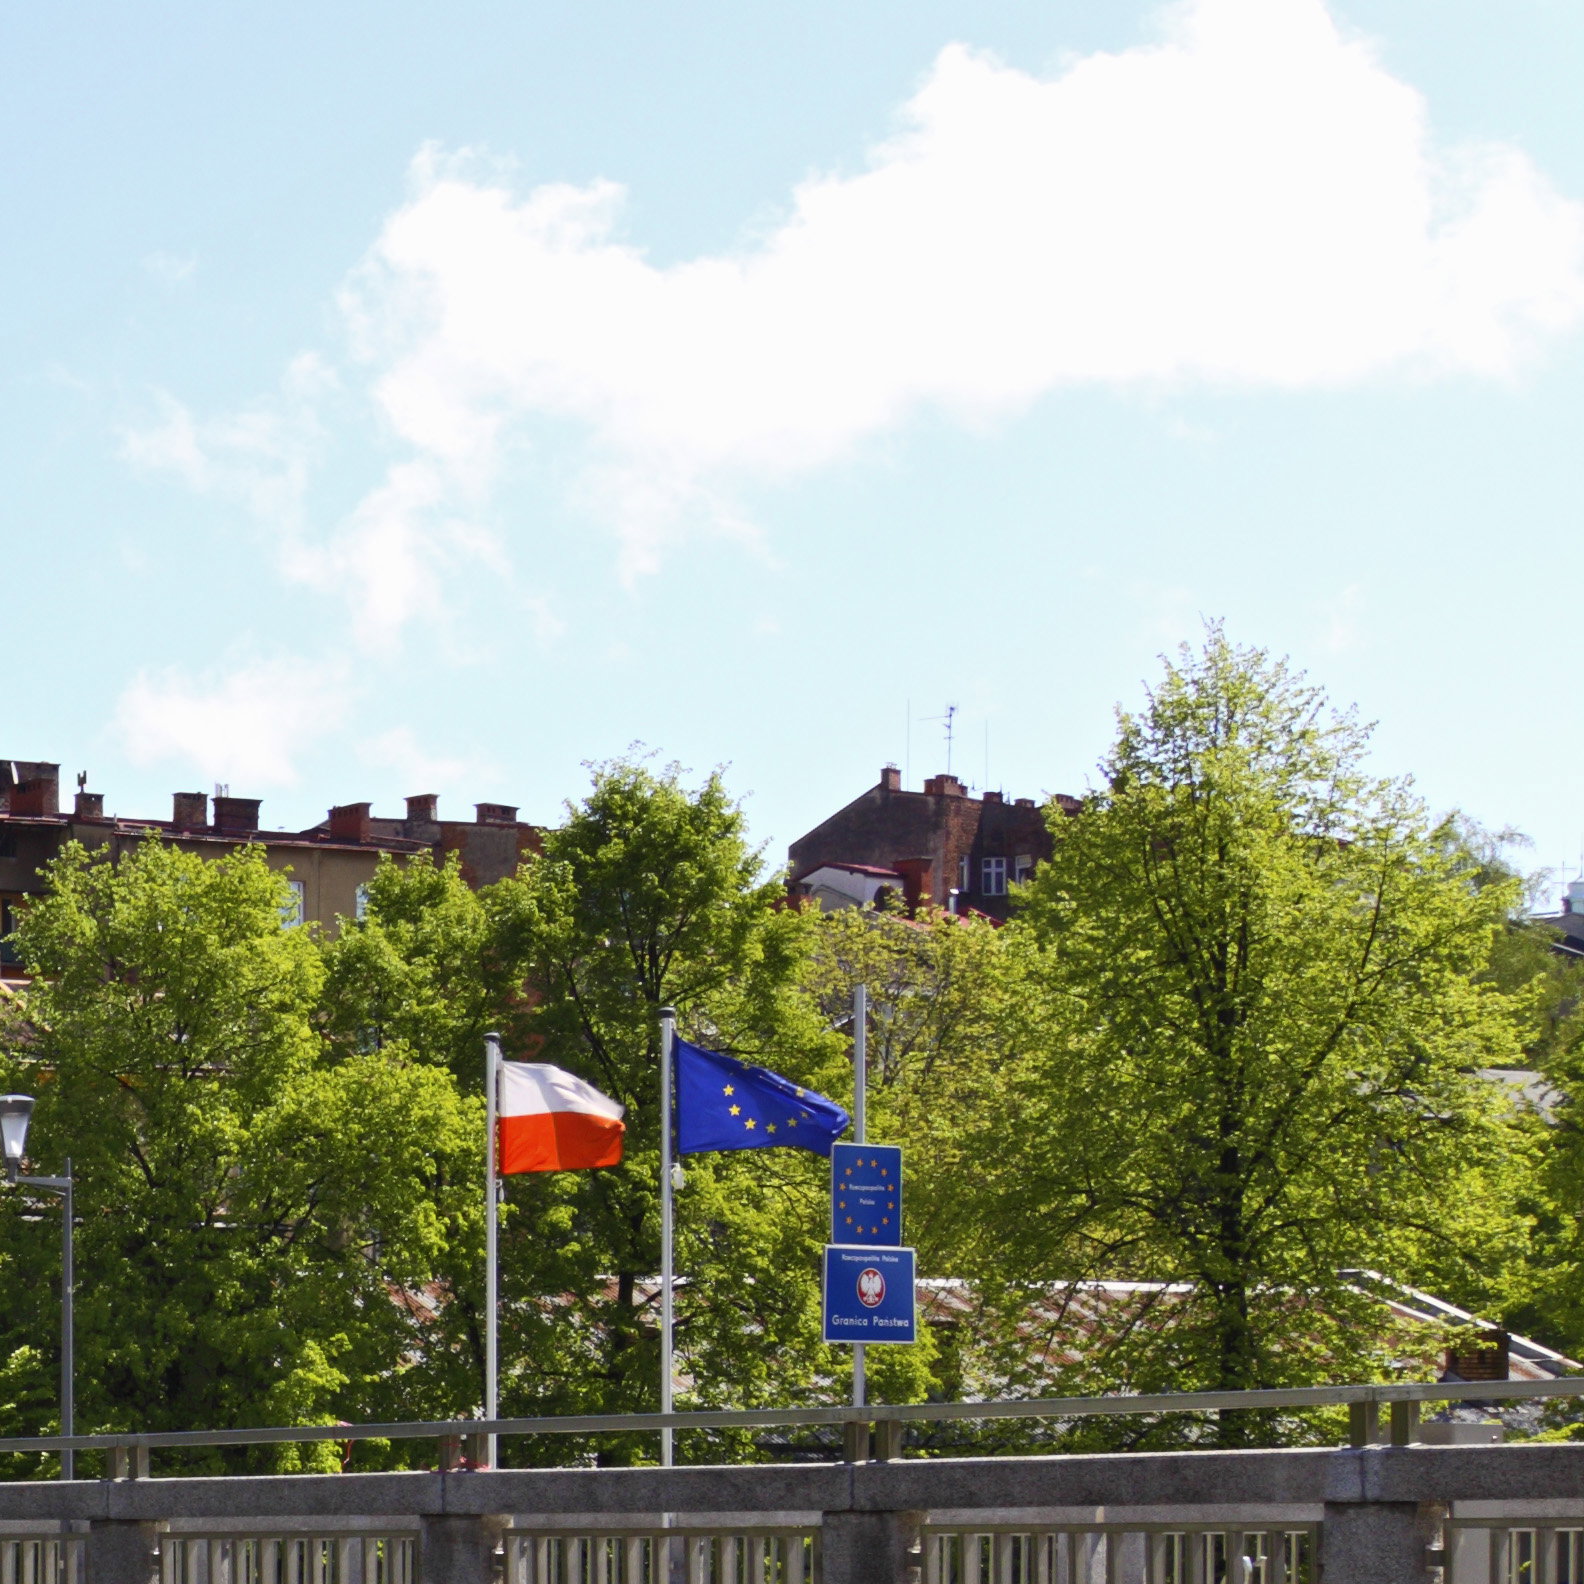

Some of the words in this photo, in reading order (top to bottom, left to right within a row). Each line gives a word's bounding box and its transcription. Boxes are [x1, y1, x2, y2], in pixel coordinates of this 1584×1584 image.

[841, 1254, 880, 1262] Rzeczpospolita
[882, 1255, 899, 1263] Polska
[832, 1314, 868, 1327] Granica
[873, 1316, 909, 1328] Państwa
